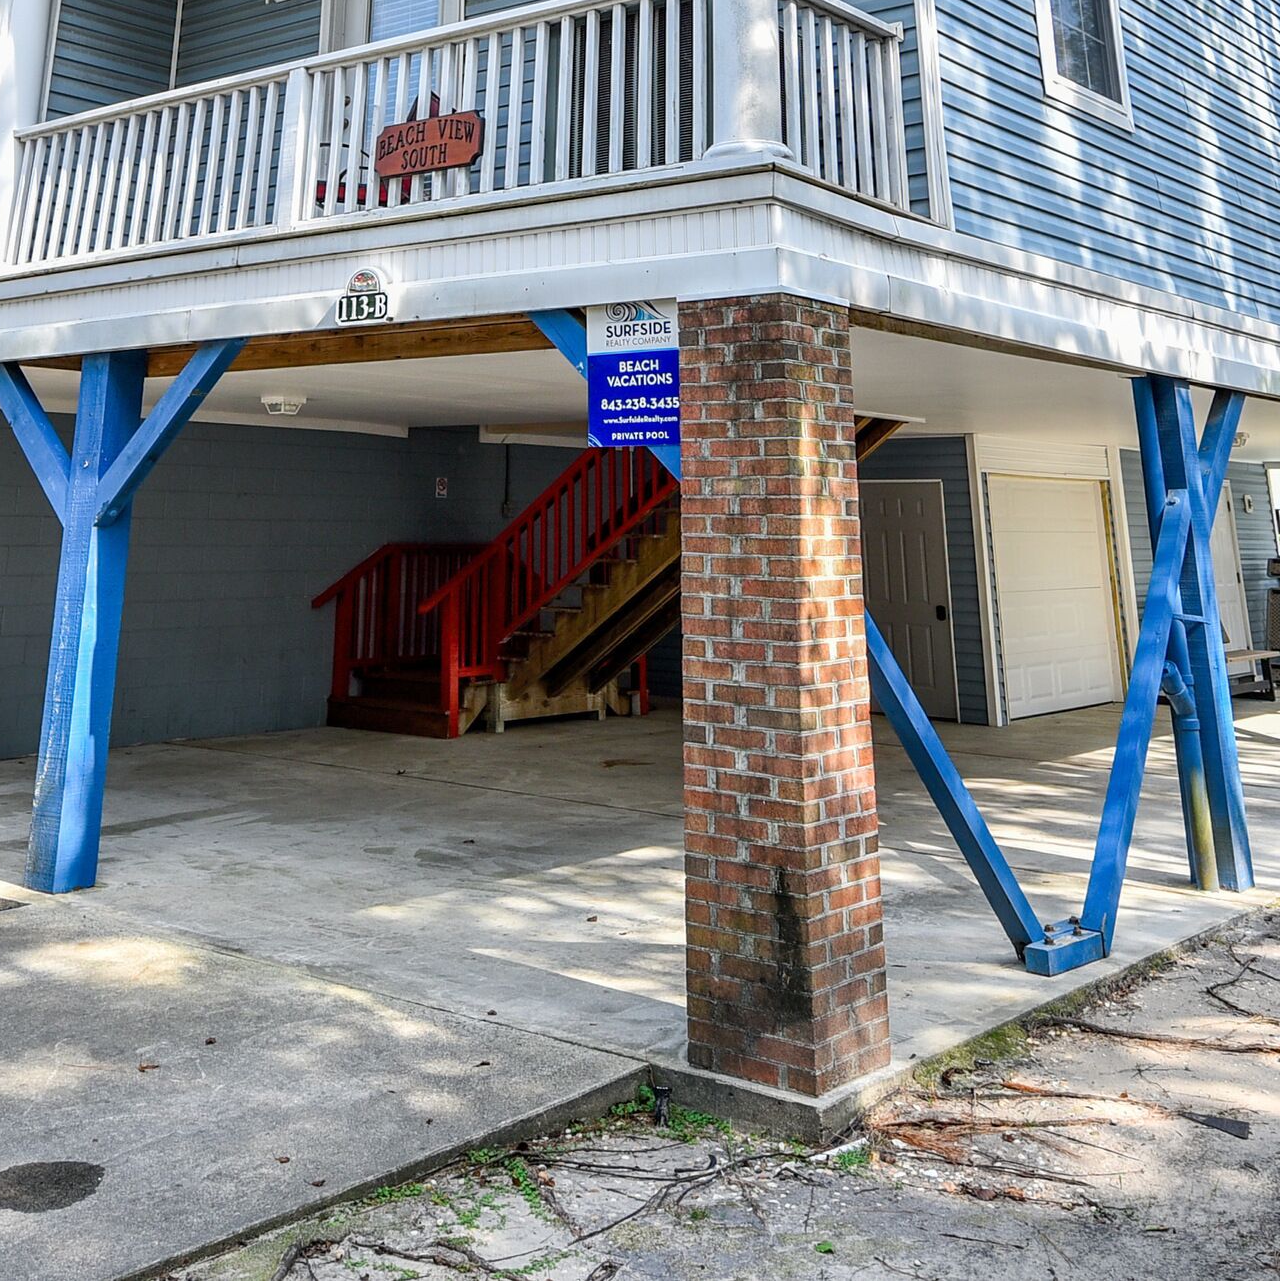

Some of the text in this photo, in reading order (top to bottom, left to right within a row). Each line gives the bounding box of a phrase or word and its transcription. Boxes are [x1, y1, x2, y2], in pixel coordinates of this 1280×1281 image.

[379, 118, 475, 161] BEACH VIEW
[401, 142, 448, 170] SOUTH
[339, 293, 386, 322] 113-B
[606, 321, 671, 338] SURFSIDE
[606, 336, 671, 348] REALTY COMPANY
[619, 359, 659, 373] BEACH
[607, 373, 673, 387] VACATIONS
[601, 397, 680, 411] 843.238.3435
[603, 415, 678, 424] www.SurfsideRealty.com
[611, 431, 670, 441] PRIVATE POOL
